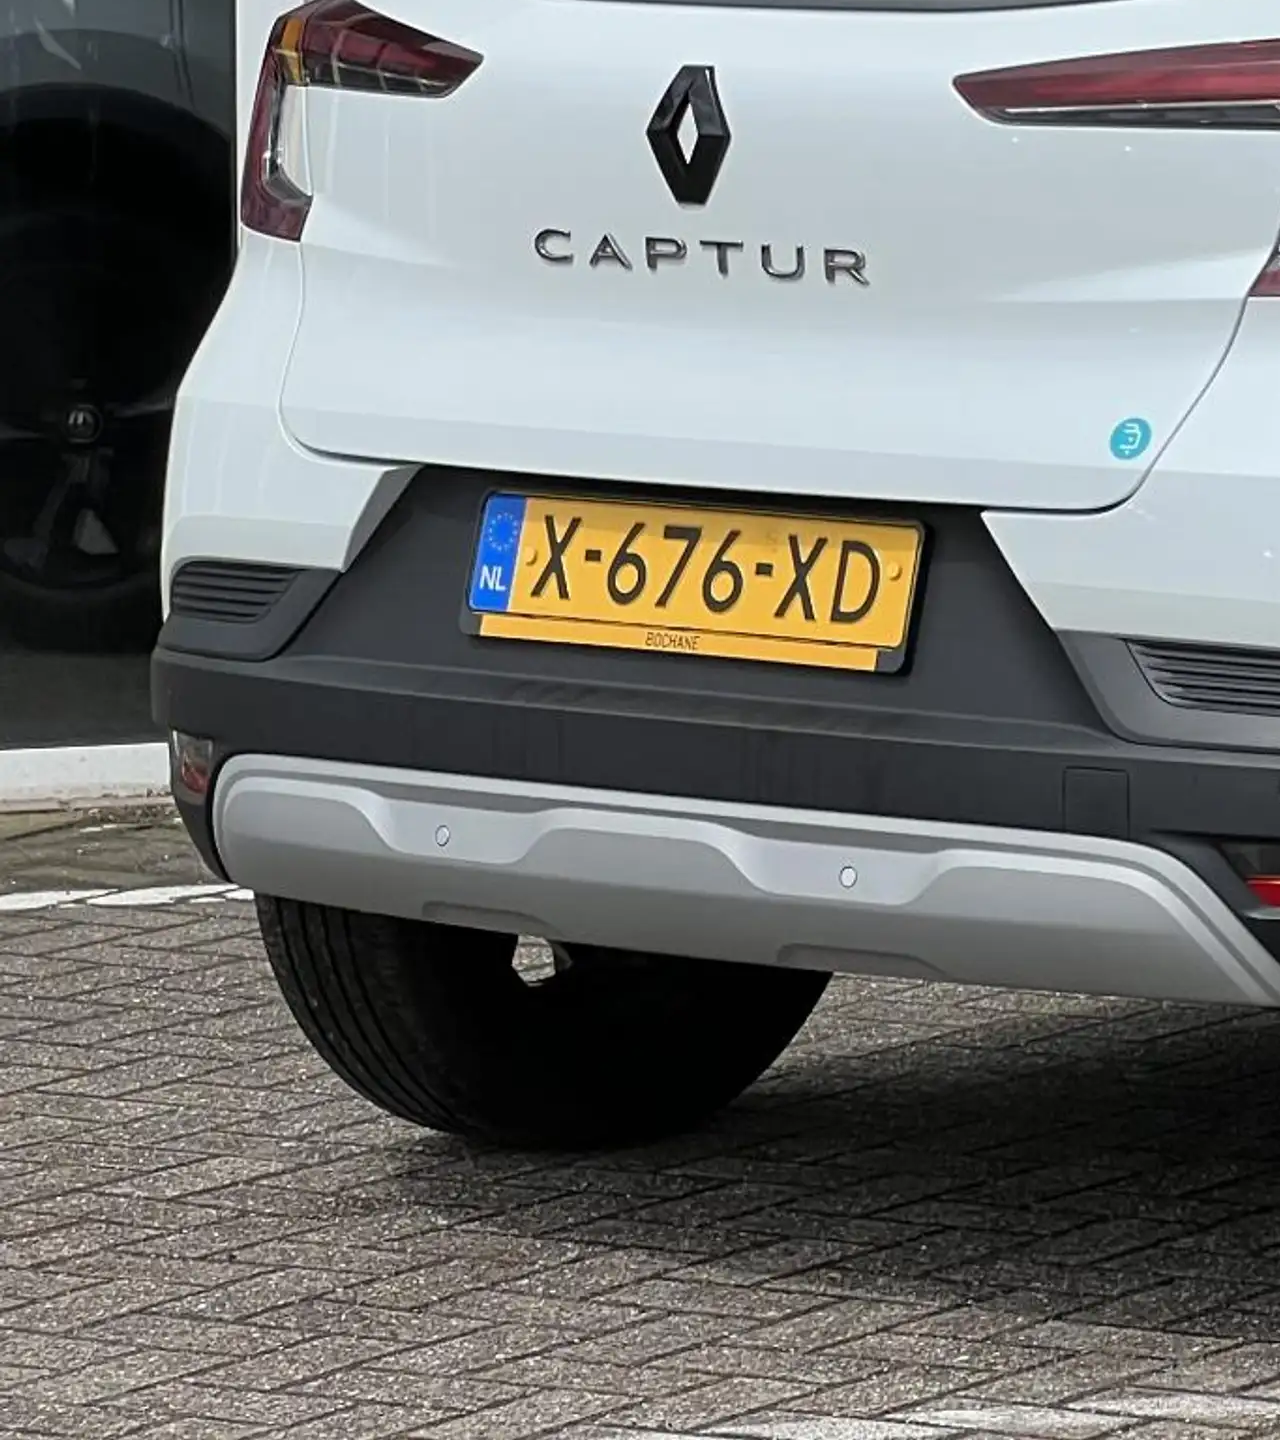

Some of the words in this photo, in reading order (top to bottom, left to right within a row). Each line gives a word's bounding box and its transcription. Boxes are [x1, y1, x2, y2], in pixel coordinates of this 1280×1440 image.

[534, 228, 871, 286] CAPTUR
[480, 565, 507, 592] NL
[530, 514, 882, 624] X-676-XD
[644, 631, 700, 651] BOCHANE
